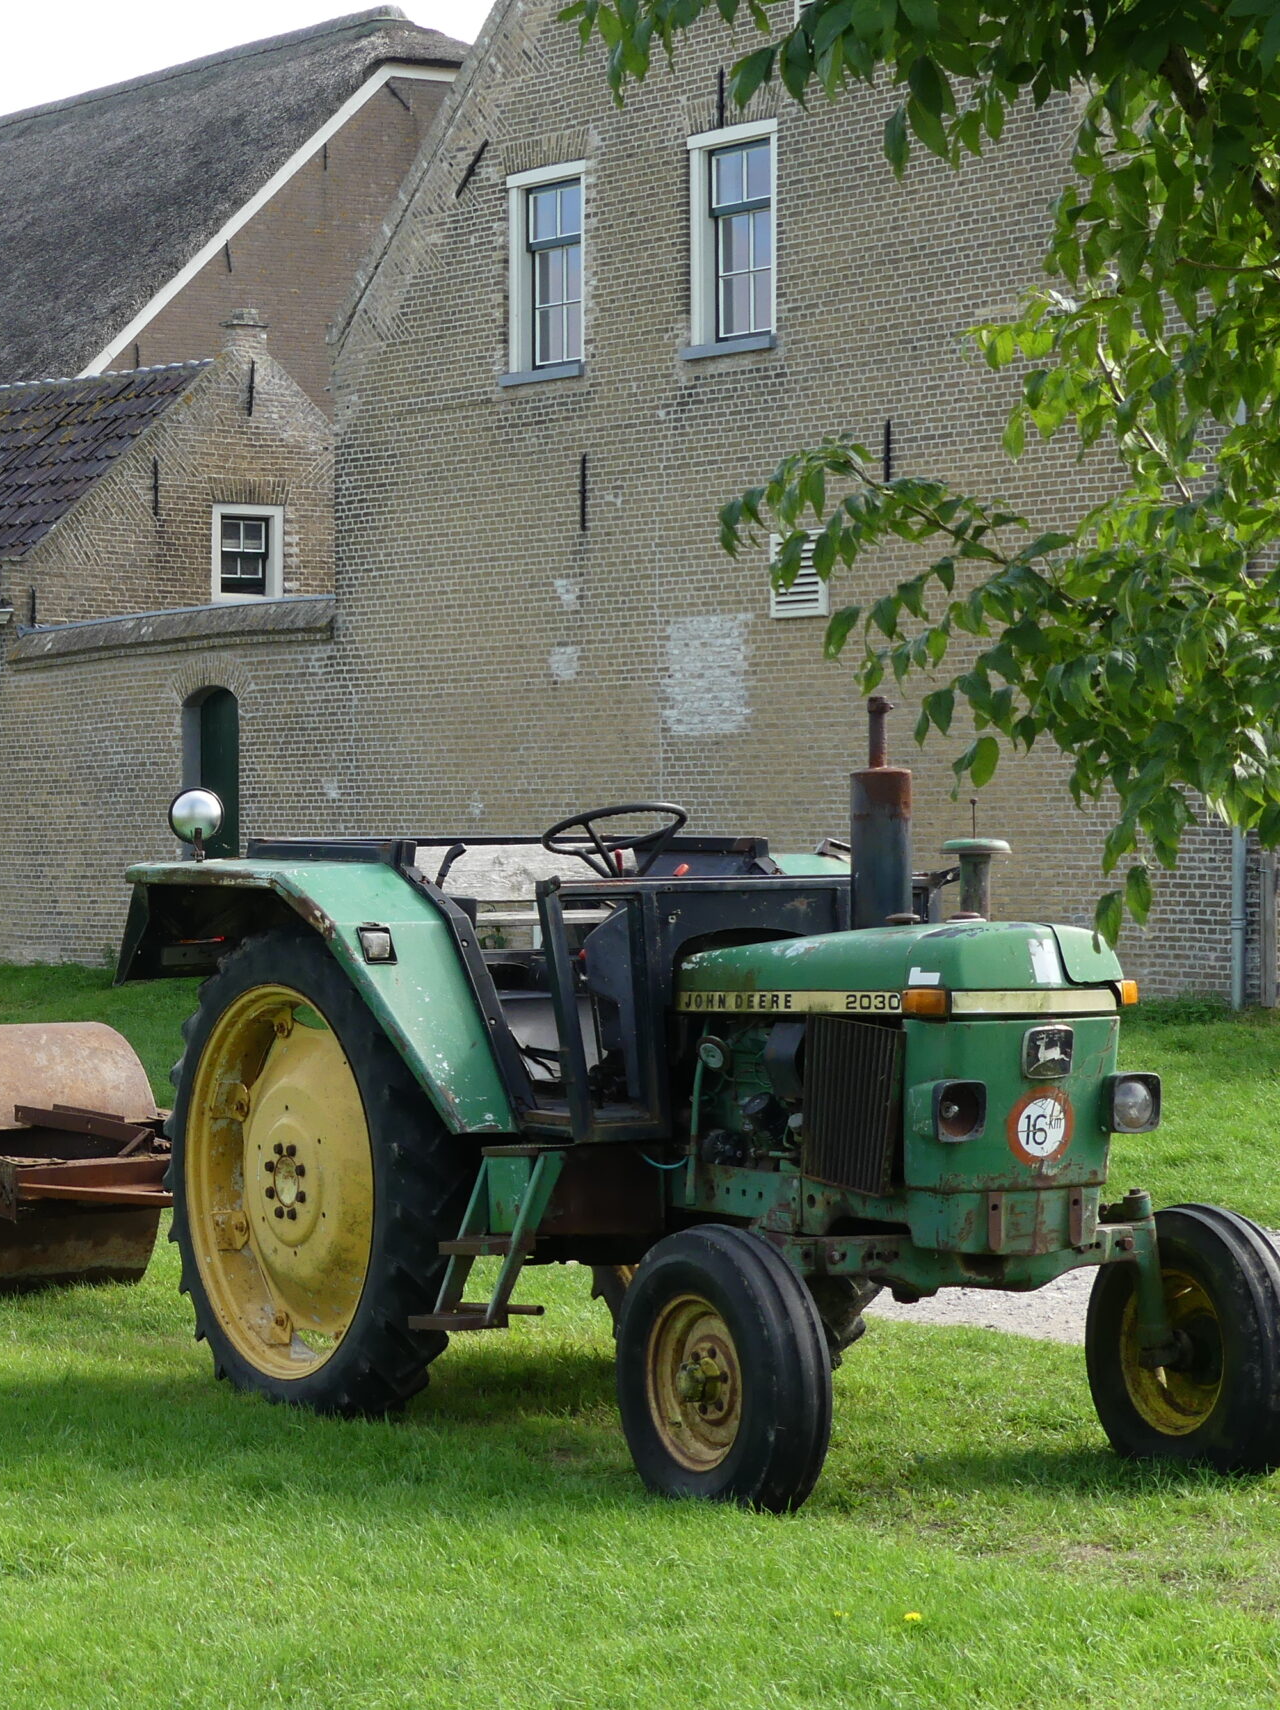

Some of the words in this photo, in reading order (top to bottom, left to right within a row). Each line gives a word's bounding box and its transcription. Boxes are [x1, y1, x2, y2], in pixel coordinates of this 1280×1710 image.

[685, 994, 726, 1010] JOHN
[735, 993, 792, 1009] DEERE
[846, 994, 900, 1010] 2030
[1025, 1114, 1047, 1145] 16
